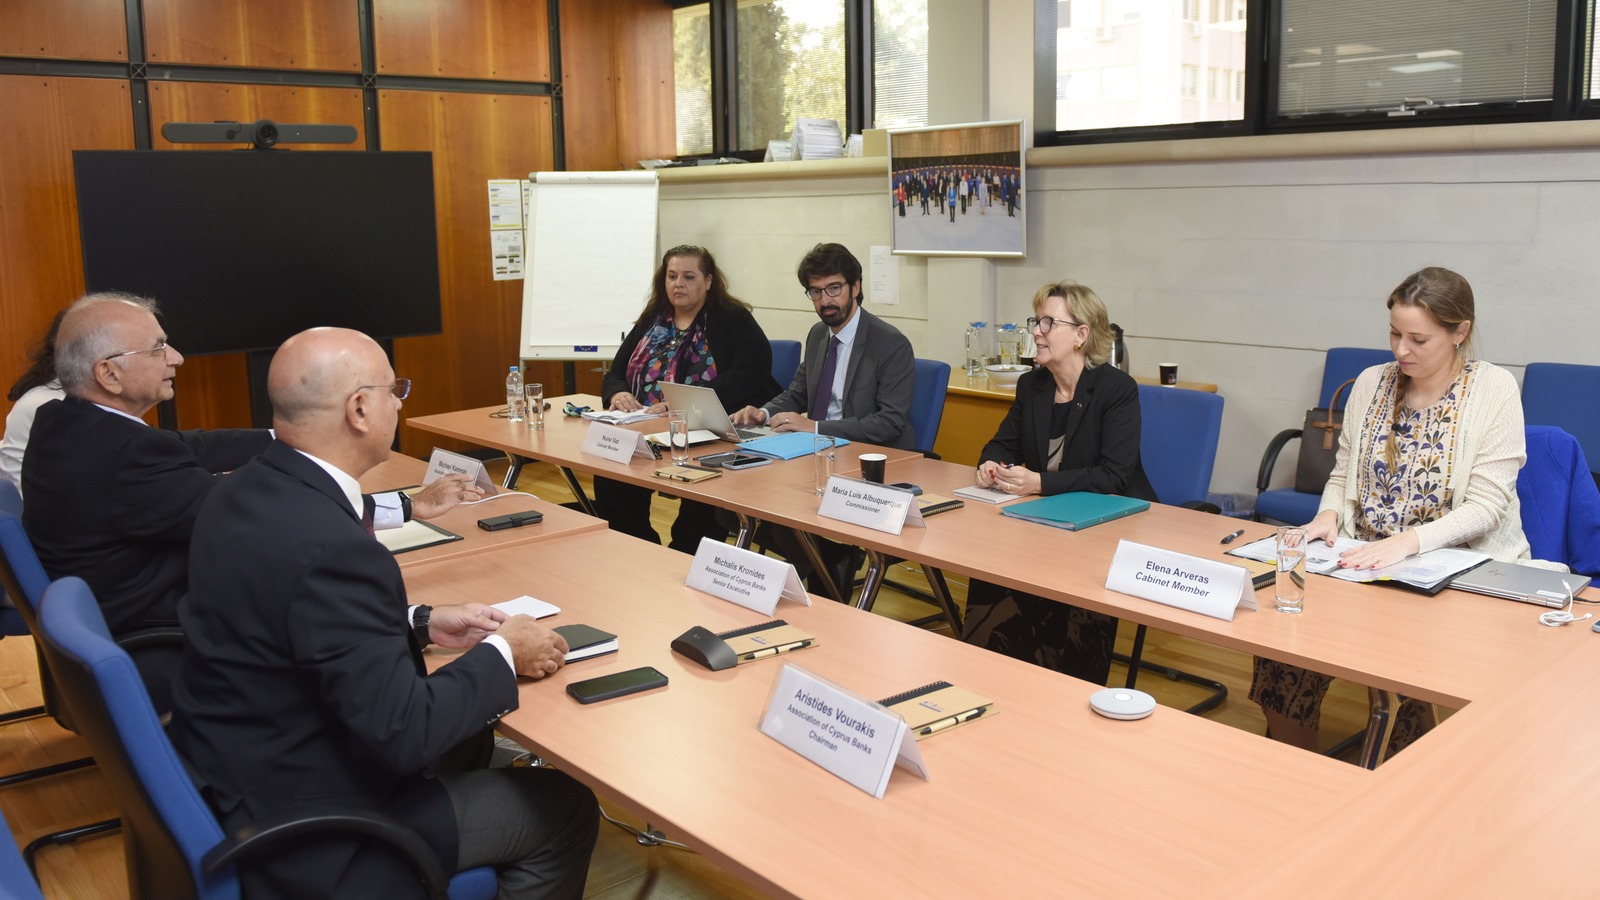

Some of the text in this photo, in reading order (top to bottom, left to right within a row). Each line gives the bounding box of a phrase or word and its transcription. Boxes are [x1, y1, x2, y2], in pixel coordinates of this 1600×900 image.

[602, 434, 620, 445] Nuno Vaz
[832, 486, 902, 508] Maria Luis Albuquerque
[845, 500, 881, 513] Commissioner
[705, 565, 730, 579] Association
[735, 575, 752, 586] Cyprus
[752, 582, 767, 592] Banks
[713, 556, 766, 580] Michalis Kronides
[1145, 560, 1209, 585] Elena Arveras
[712, 577, 727, 588] Senior
[1135, 571, 1210, 597] Cabinet Member
[794, 689, 876, 739] Aristides Vourakis
[787, 704, 872, 755] Association of Cyprus Banks
[808, 730, 838, 752] Chairman
